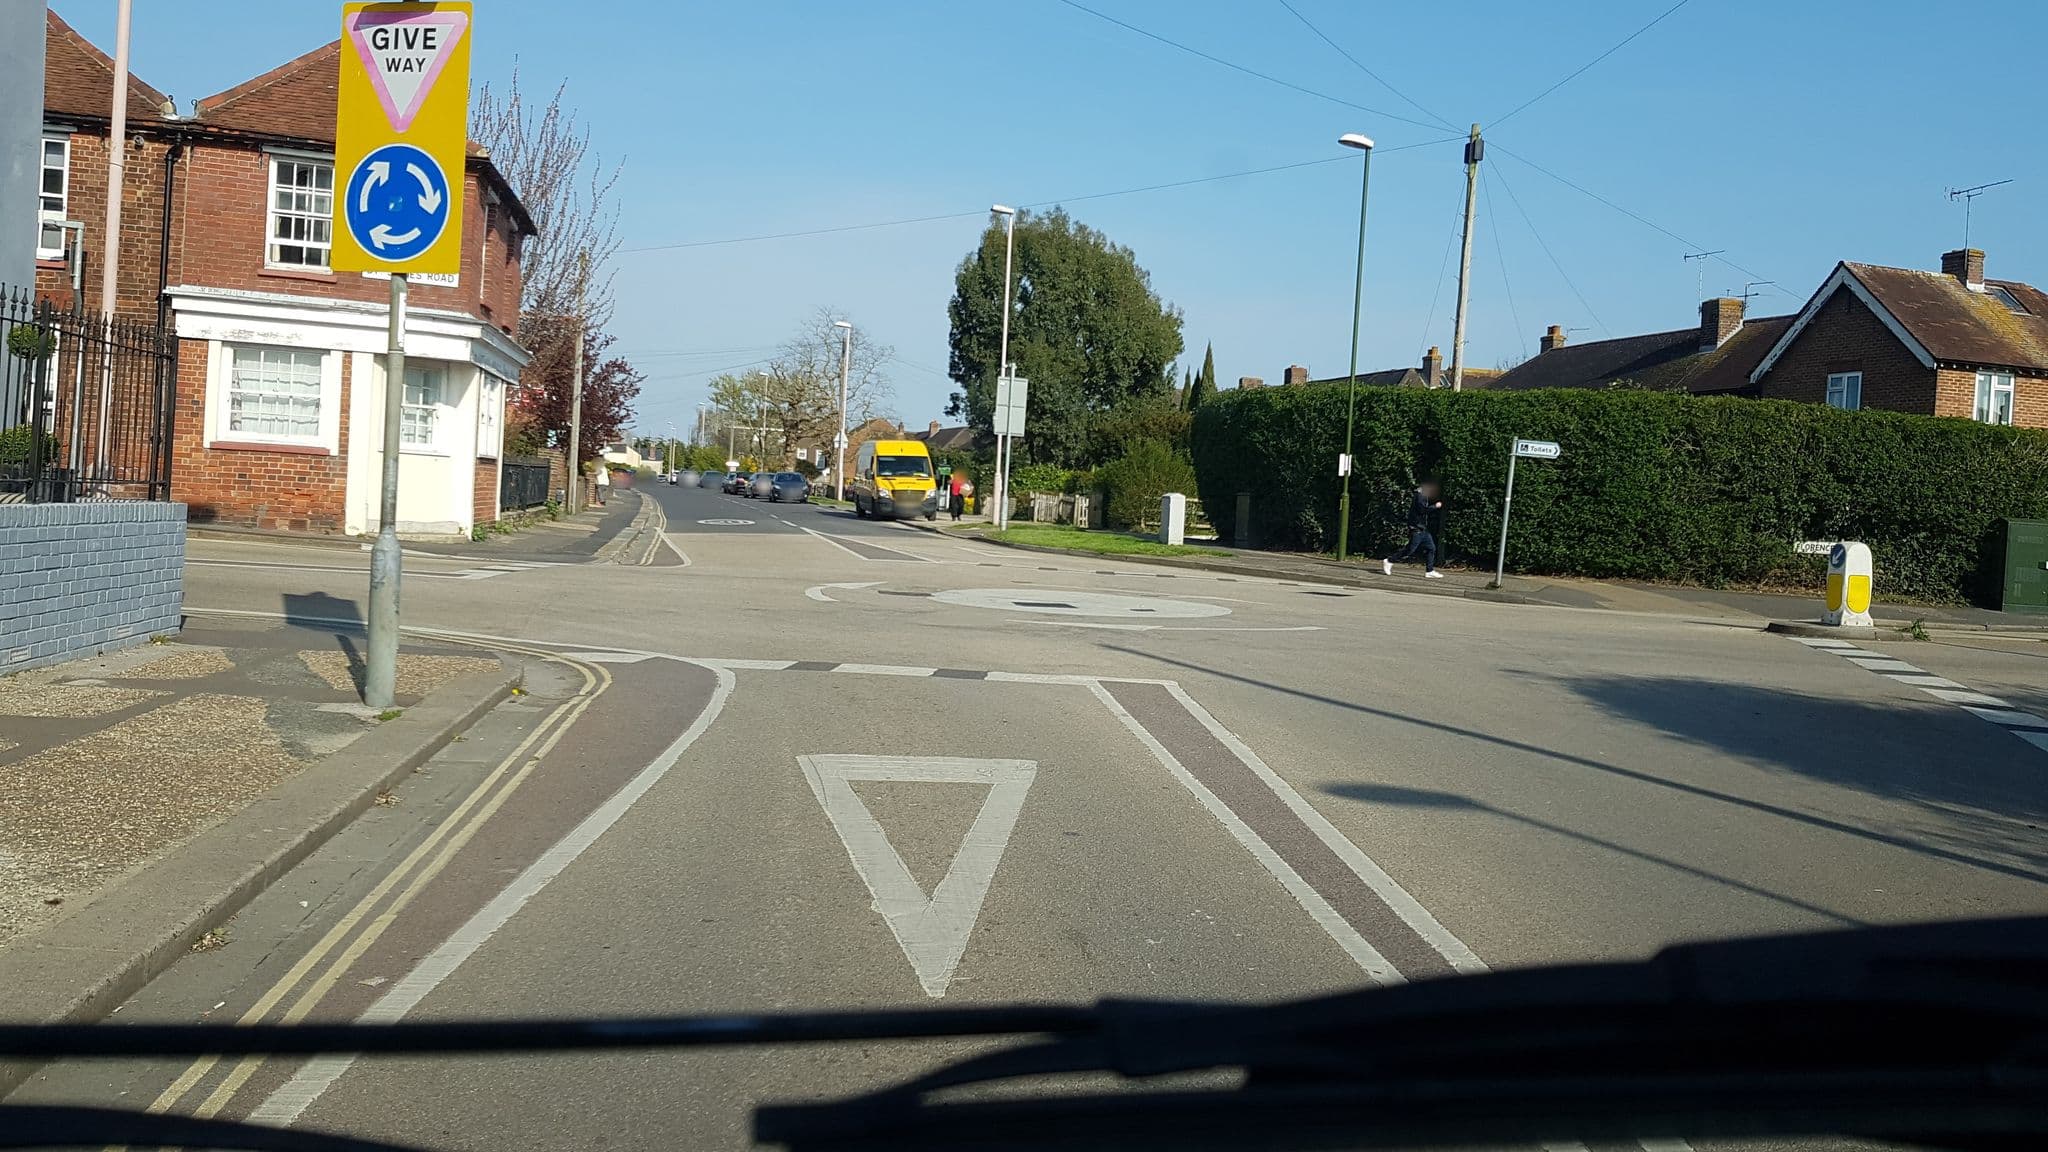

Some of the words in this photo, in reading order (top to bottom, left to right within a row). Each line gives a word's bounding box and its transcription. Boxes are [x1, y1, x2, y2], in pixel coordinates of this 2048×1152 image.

[372, 28, 436, 50] GIVE
[386, 58, 426, 72] WAY
[427, 272, 455, 283] ROAD
